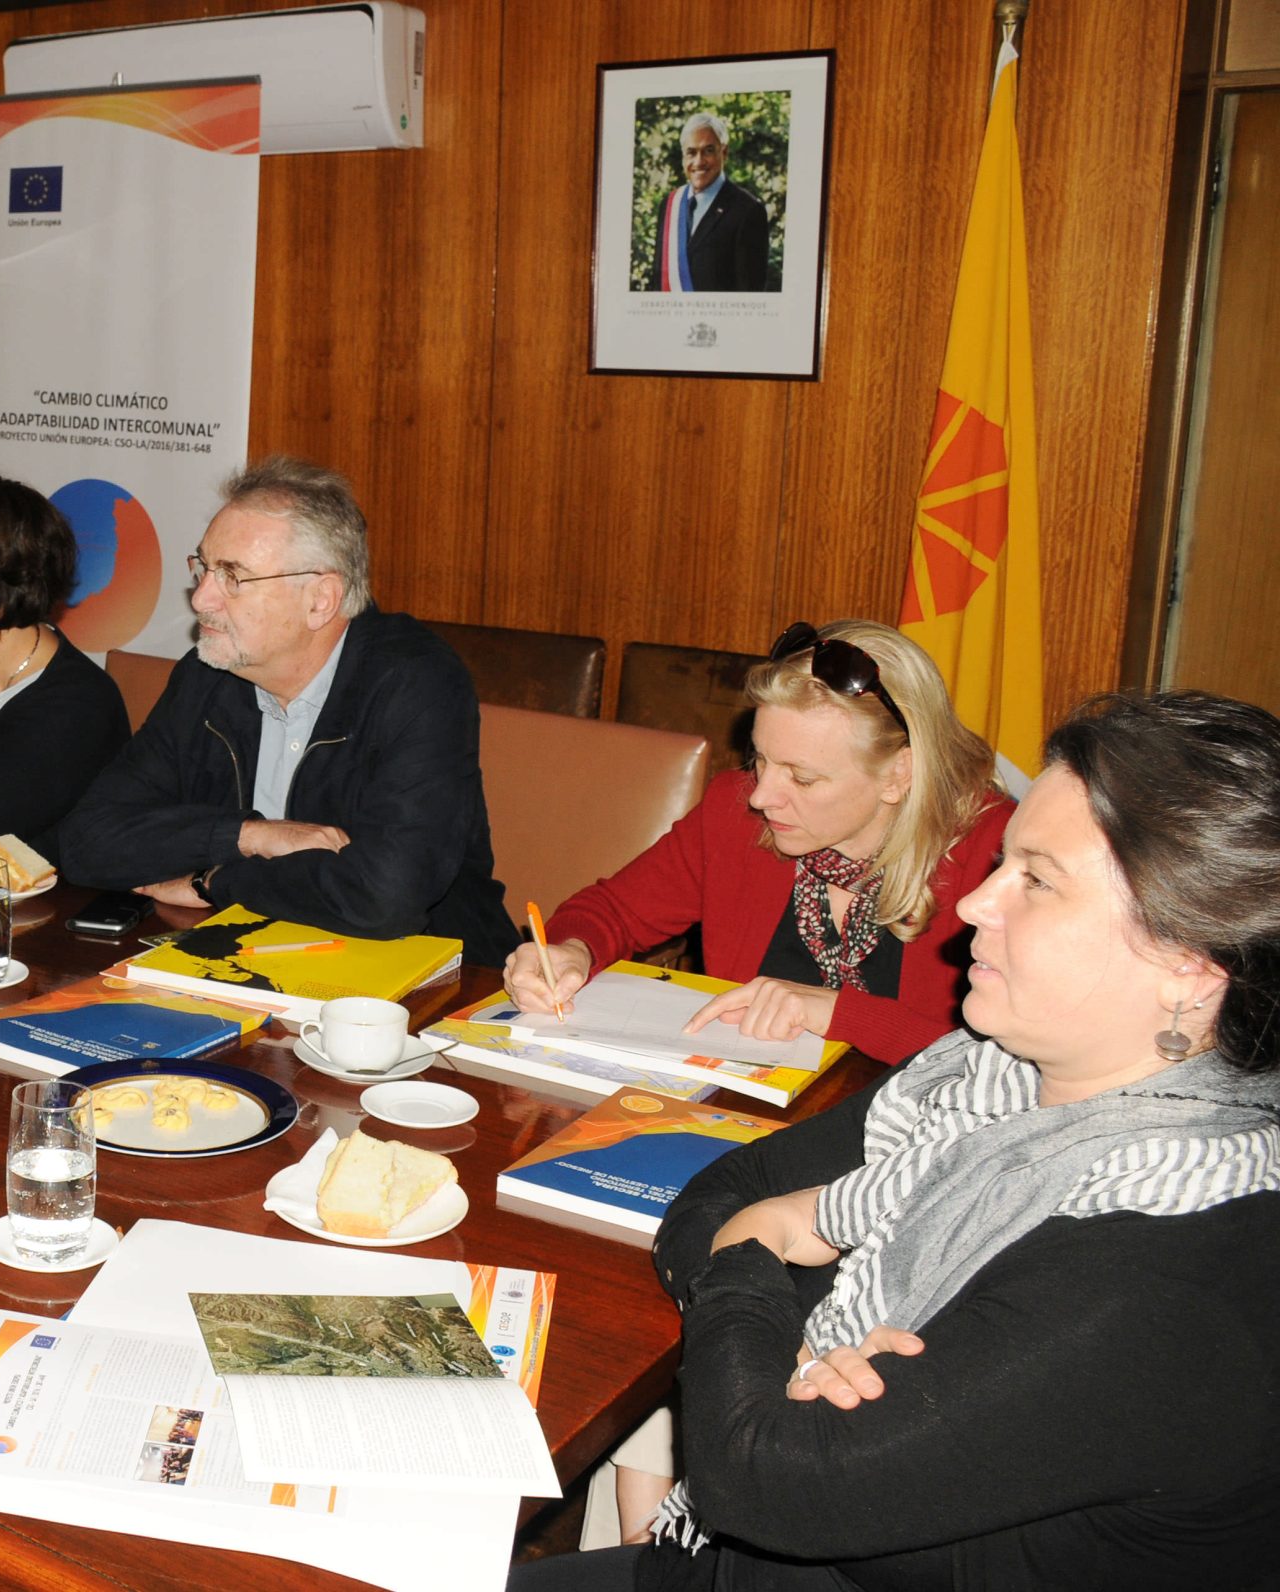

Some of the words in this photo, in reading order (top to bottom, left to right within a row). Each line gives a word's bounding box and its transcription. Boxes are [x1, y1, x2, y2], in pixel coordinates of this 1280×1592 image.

[31, 218, 62, 228] Europea
[95, 392, 168, 410] CLIMÁTICO
[0, 412, 100, 430] ADAPTABILIDAD
[39, 431, 68, 445] UNIÓN
[70, 435, 113, 447] EUROPEA:
[115, 438, 212, 454] CSO-LA/2016/381-648
